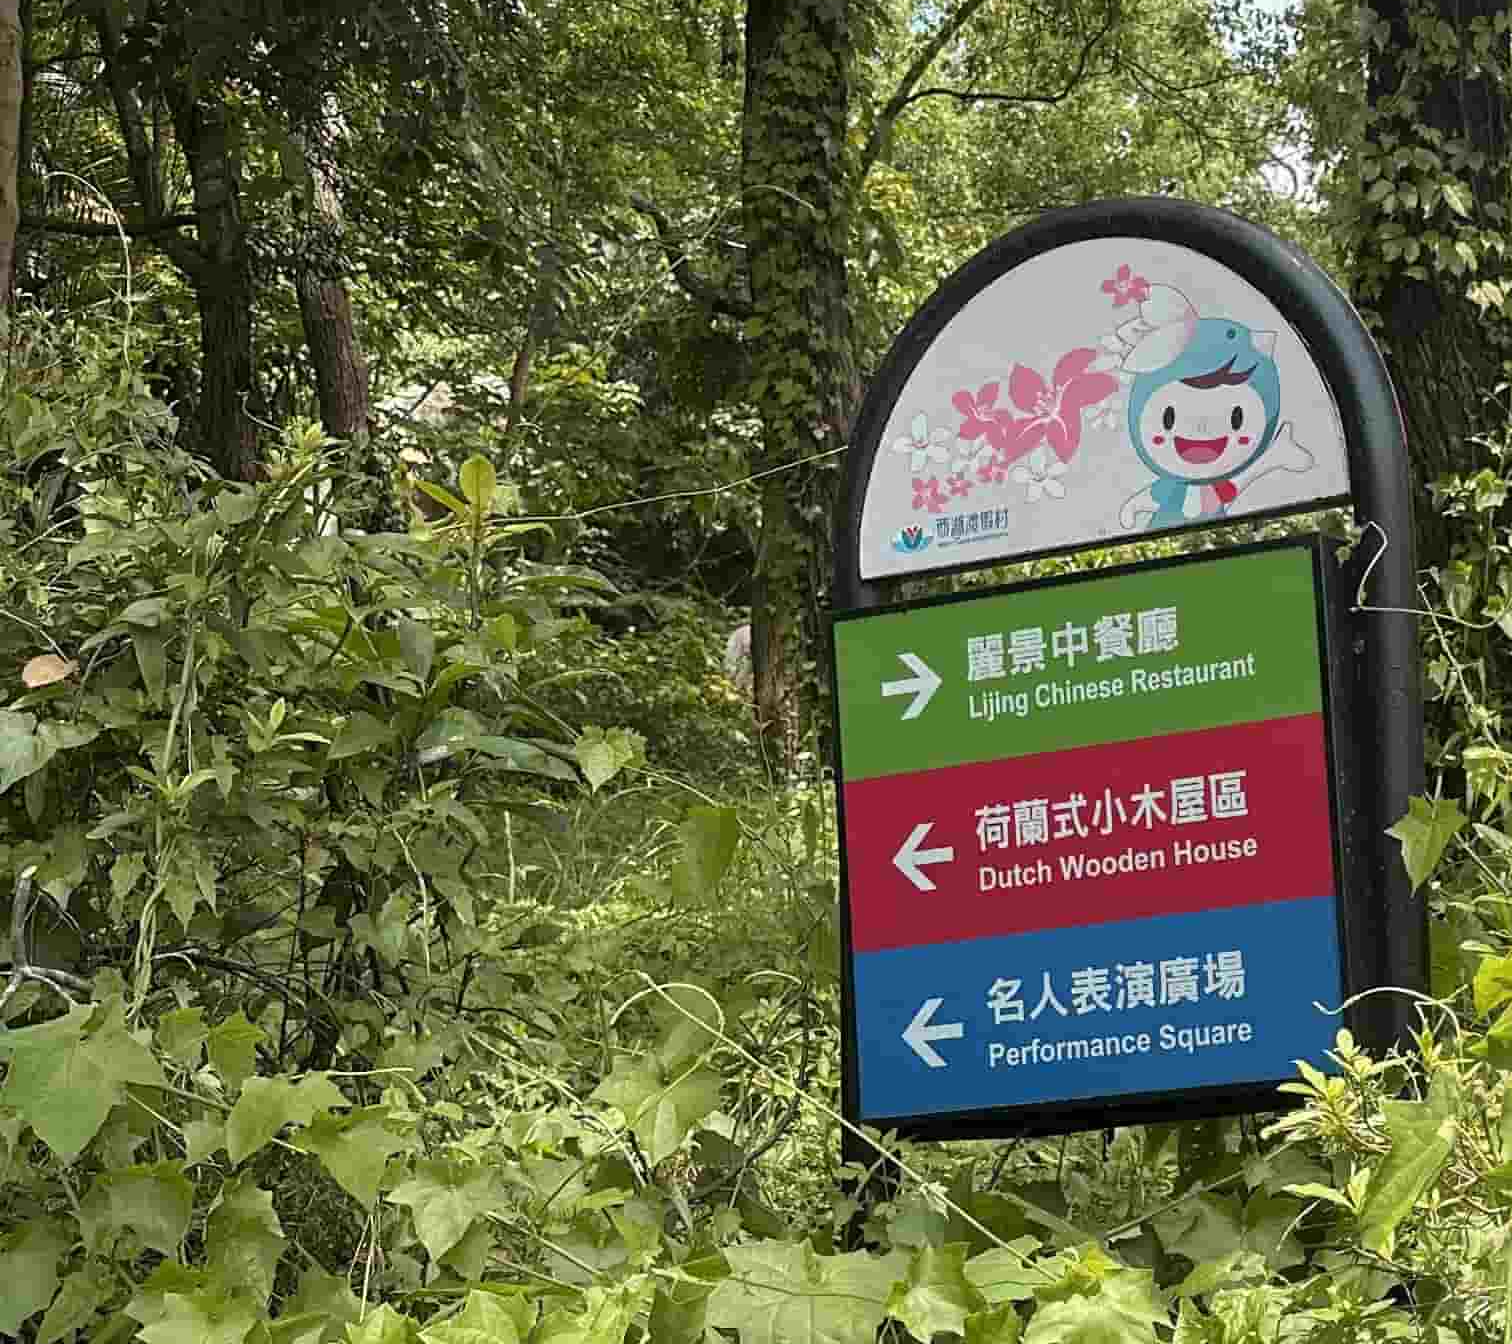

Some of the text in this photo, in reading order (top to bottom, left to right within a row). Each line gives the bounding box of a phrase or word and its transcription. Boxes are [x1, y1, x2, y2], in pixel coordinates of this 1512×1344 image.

[966, 606, 1180, 682] 麗景中餐廳
[968, 653, 1257, 722] Lijing Chinese Restaurant
[974, 769, 1249, 852] 荷蘭式小木屋區
[978, 837, 1259, 892] Dutch Wooden House
[986, 950, 1247, 1025] 名人表演廣場
[988, 1021, 1253, 1068] Performance Square
